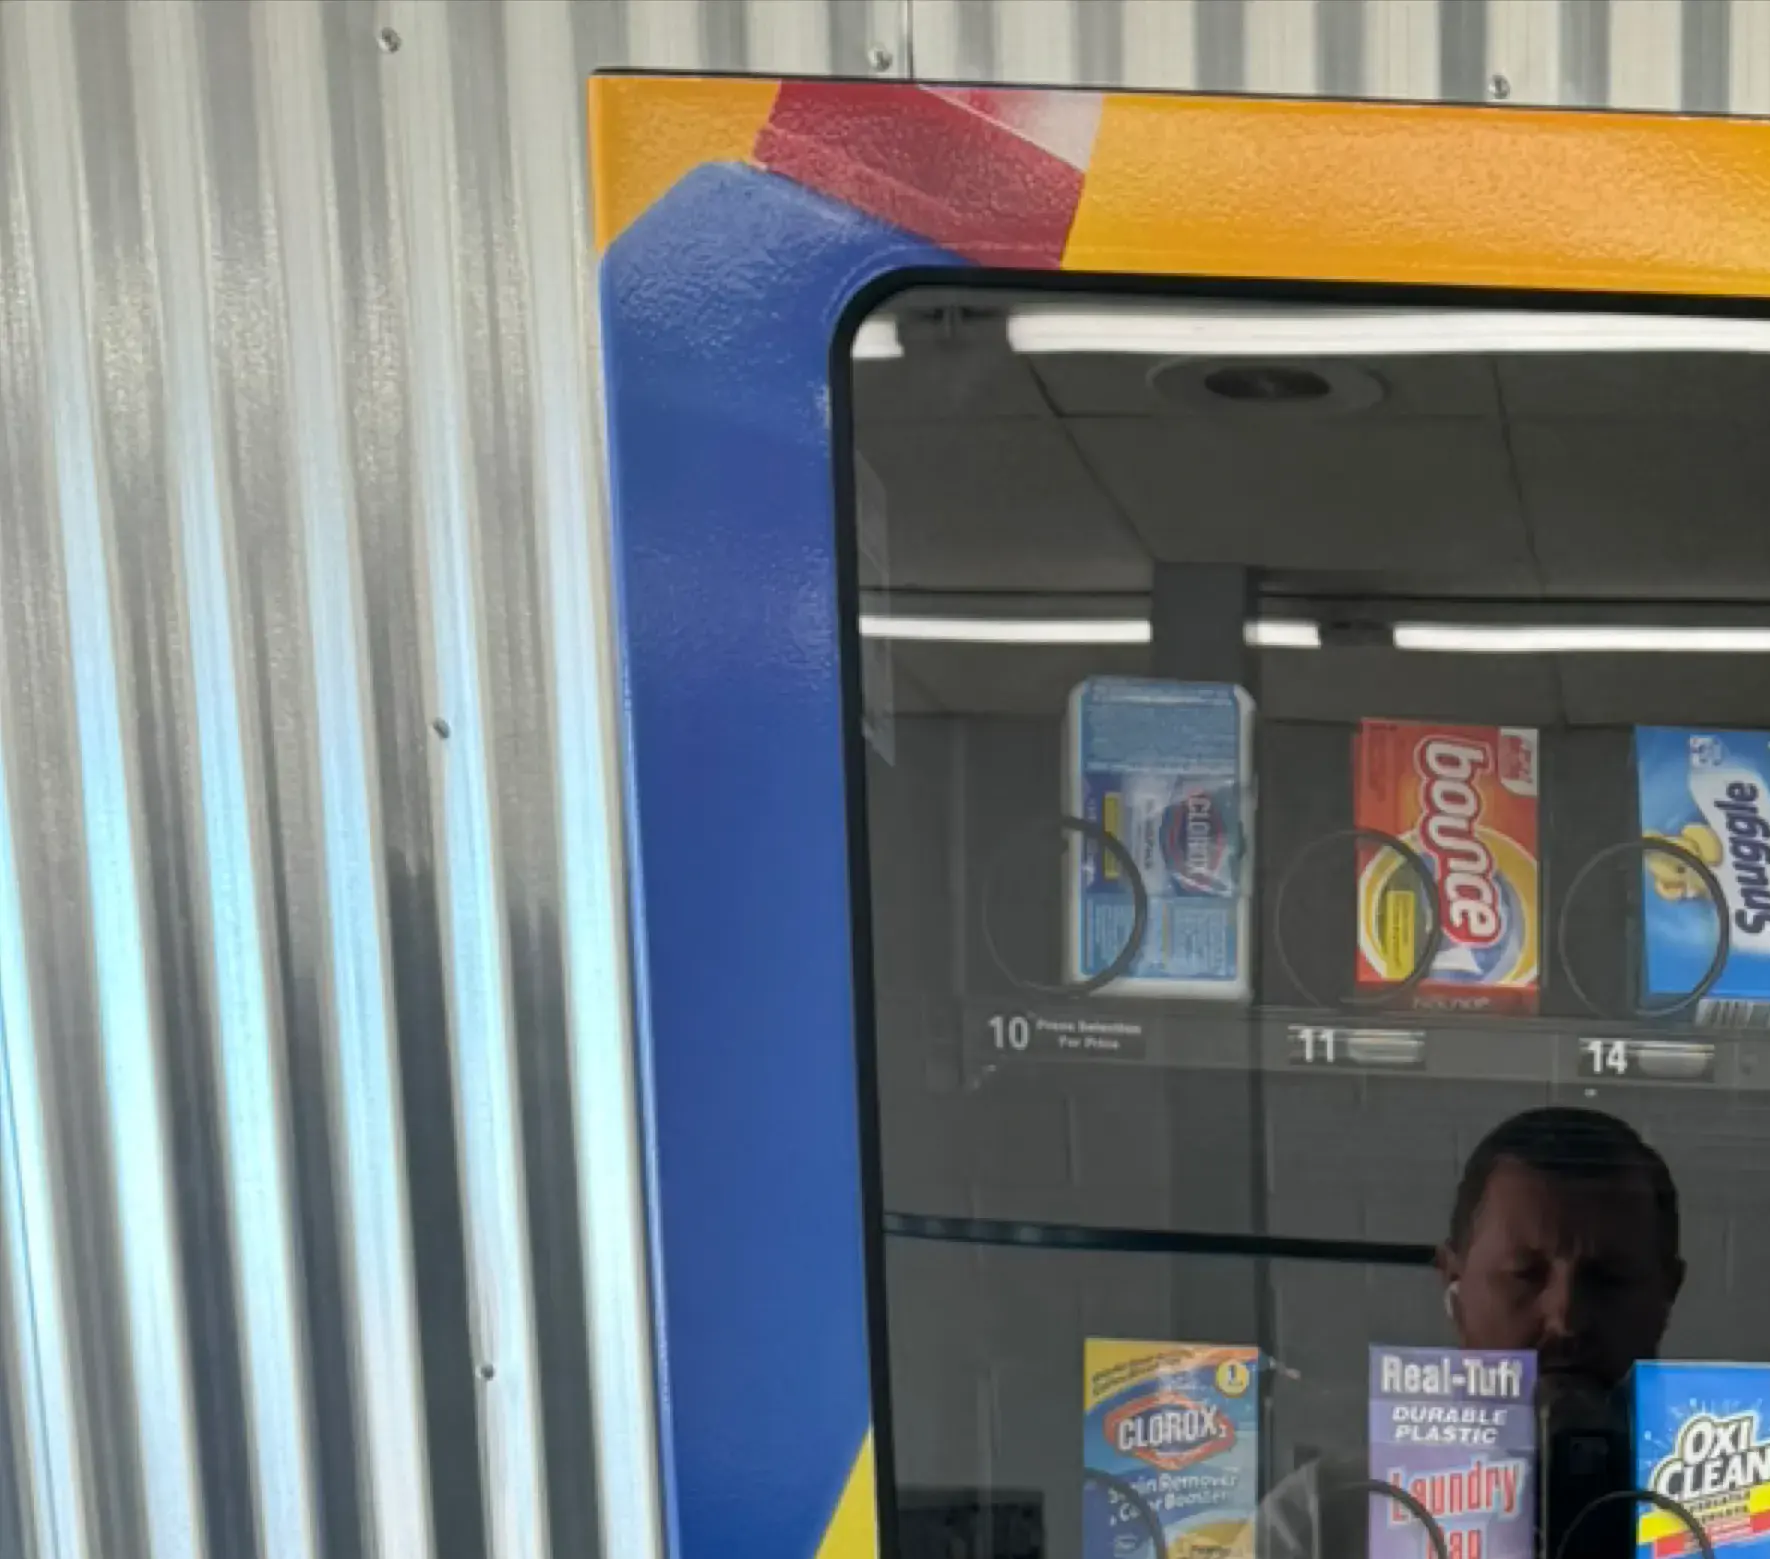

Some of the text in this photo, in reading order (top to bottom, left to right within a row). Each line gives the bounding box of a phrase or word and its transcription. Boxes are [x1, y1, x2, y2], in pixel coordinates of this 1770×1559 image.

[1425, 740, 1496, 937] bounce
[989, 1015, 1029, 1051] 10
[1302, 1027, 1335, 1063] 11
[1588, 1039, 1628, 1074] 14
[1392, 1406, 1507, 1426] DURABLE
[1395, 1425, 1499, 1445] PLASTIC
[1683, 1419, 1750, 1462] OXI
[1390, 1460, 1520, 1523] Laundry
